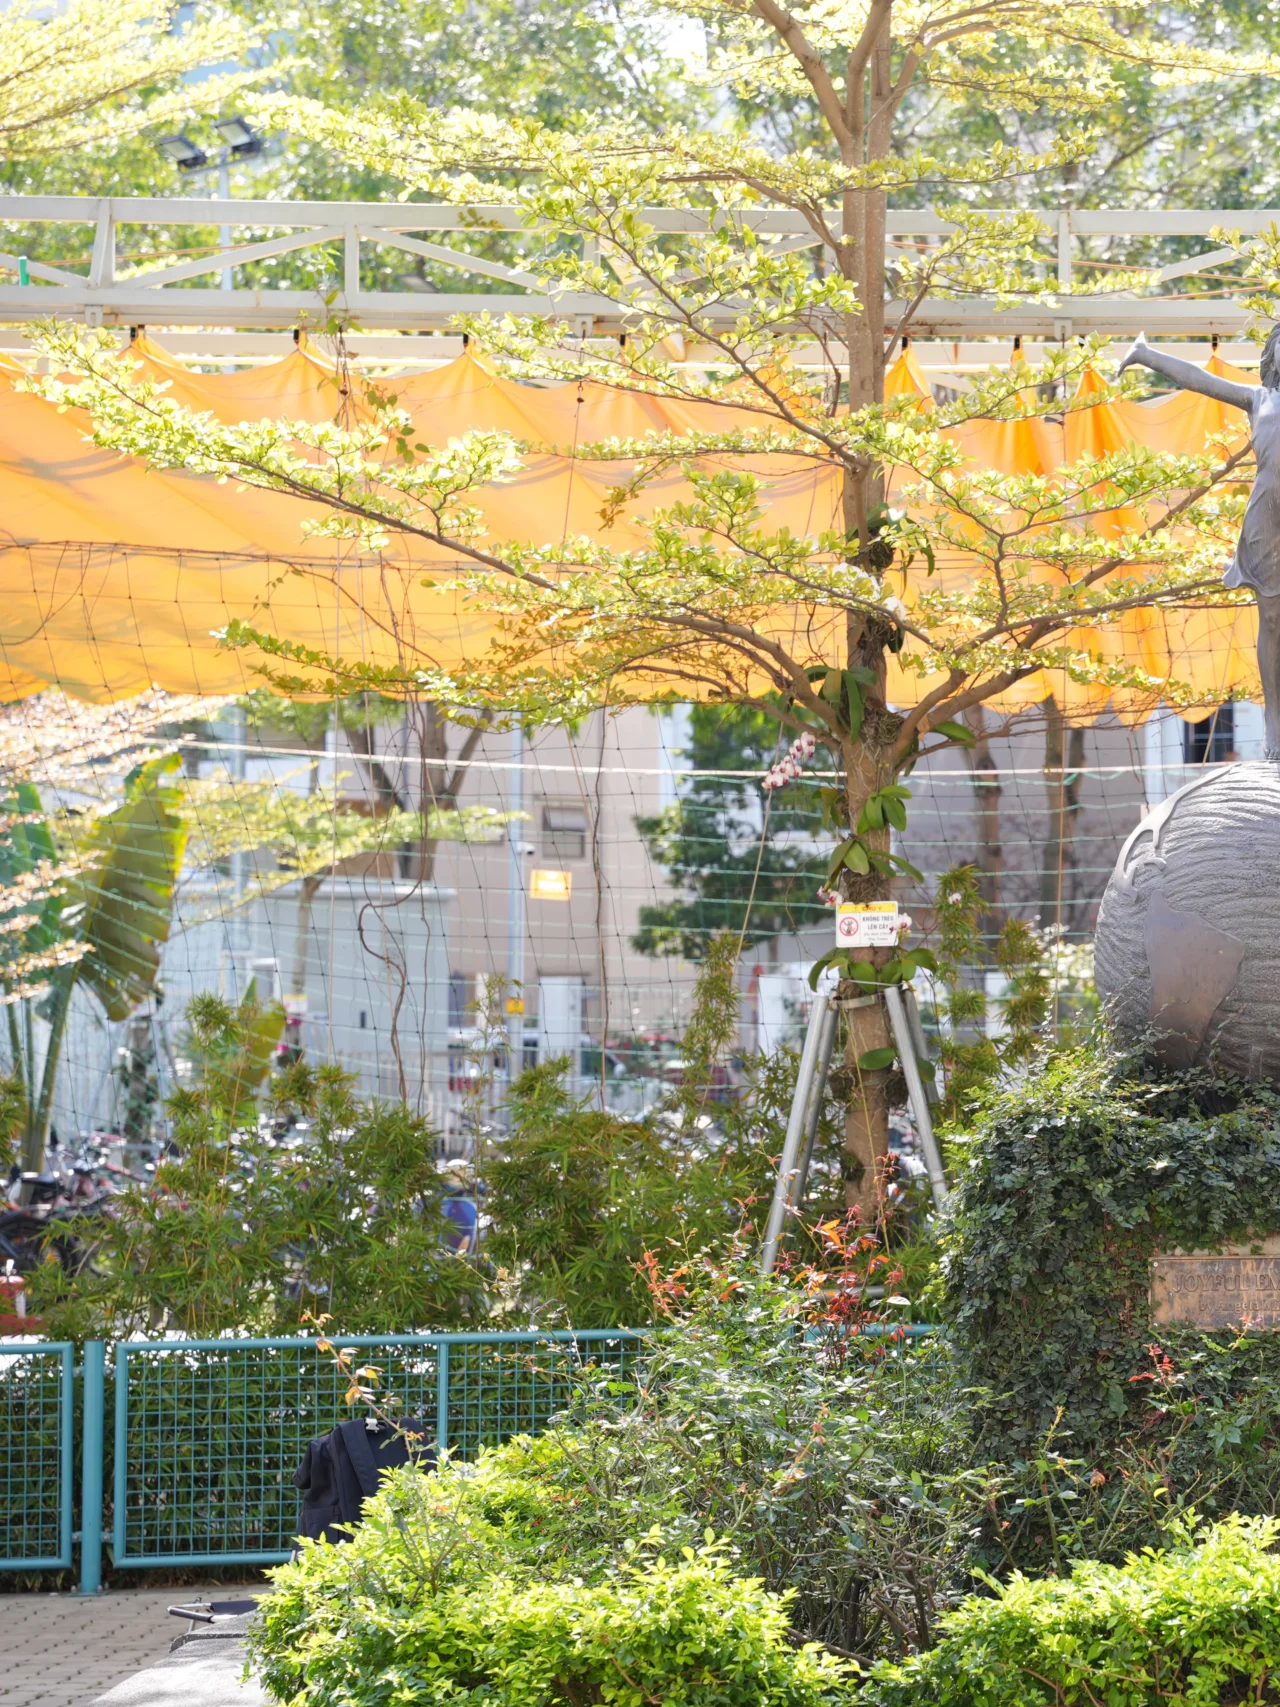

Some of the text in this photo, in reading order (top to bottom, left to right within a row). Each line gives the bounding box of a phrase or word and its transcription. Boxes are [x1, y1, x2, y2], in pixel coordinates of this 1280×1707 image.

[1172, 1273, 1250, 1293] JOYFUL
[1199, 1300, 1215, 1315] by
[1217, 1299, 1260, 1314] Angela
